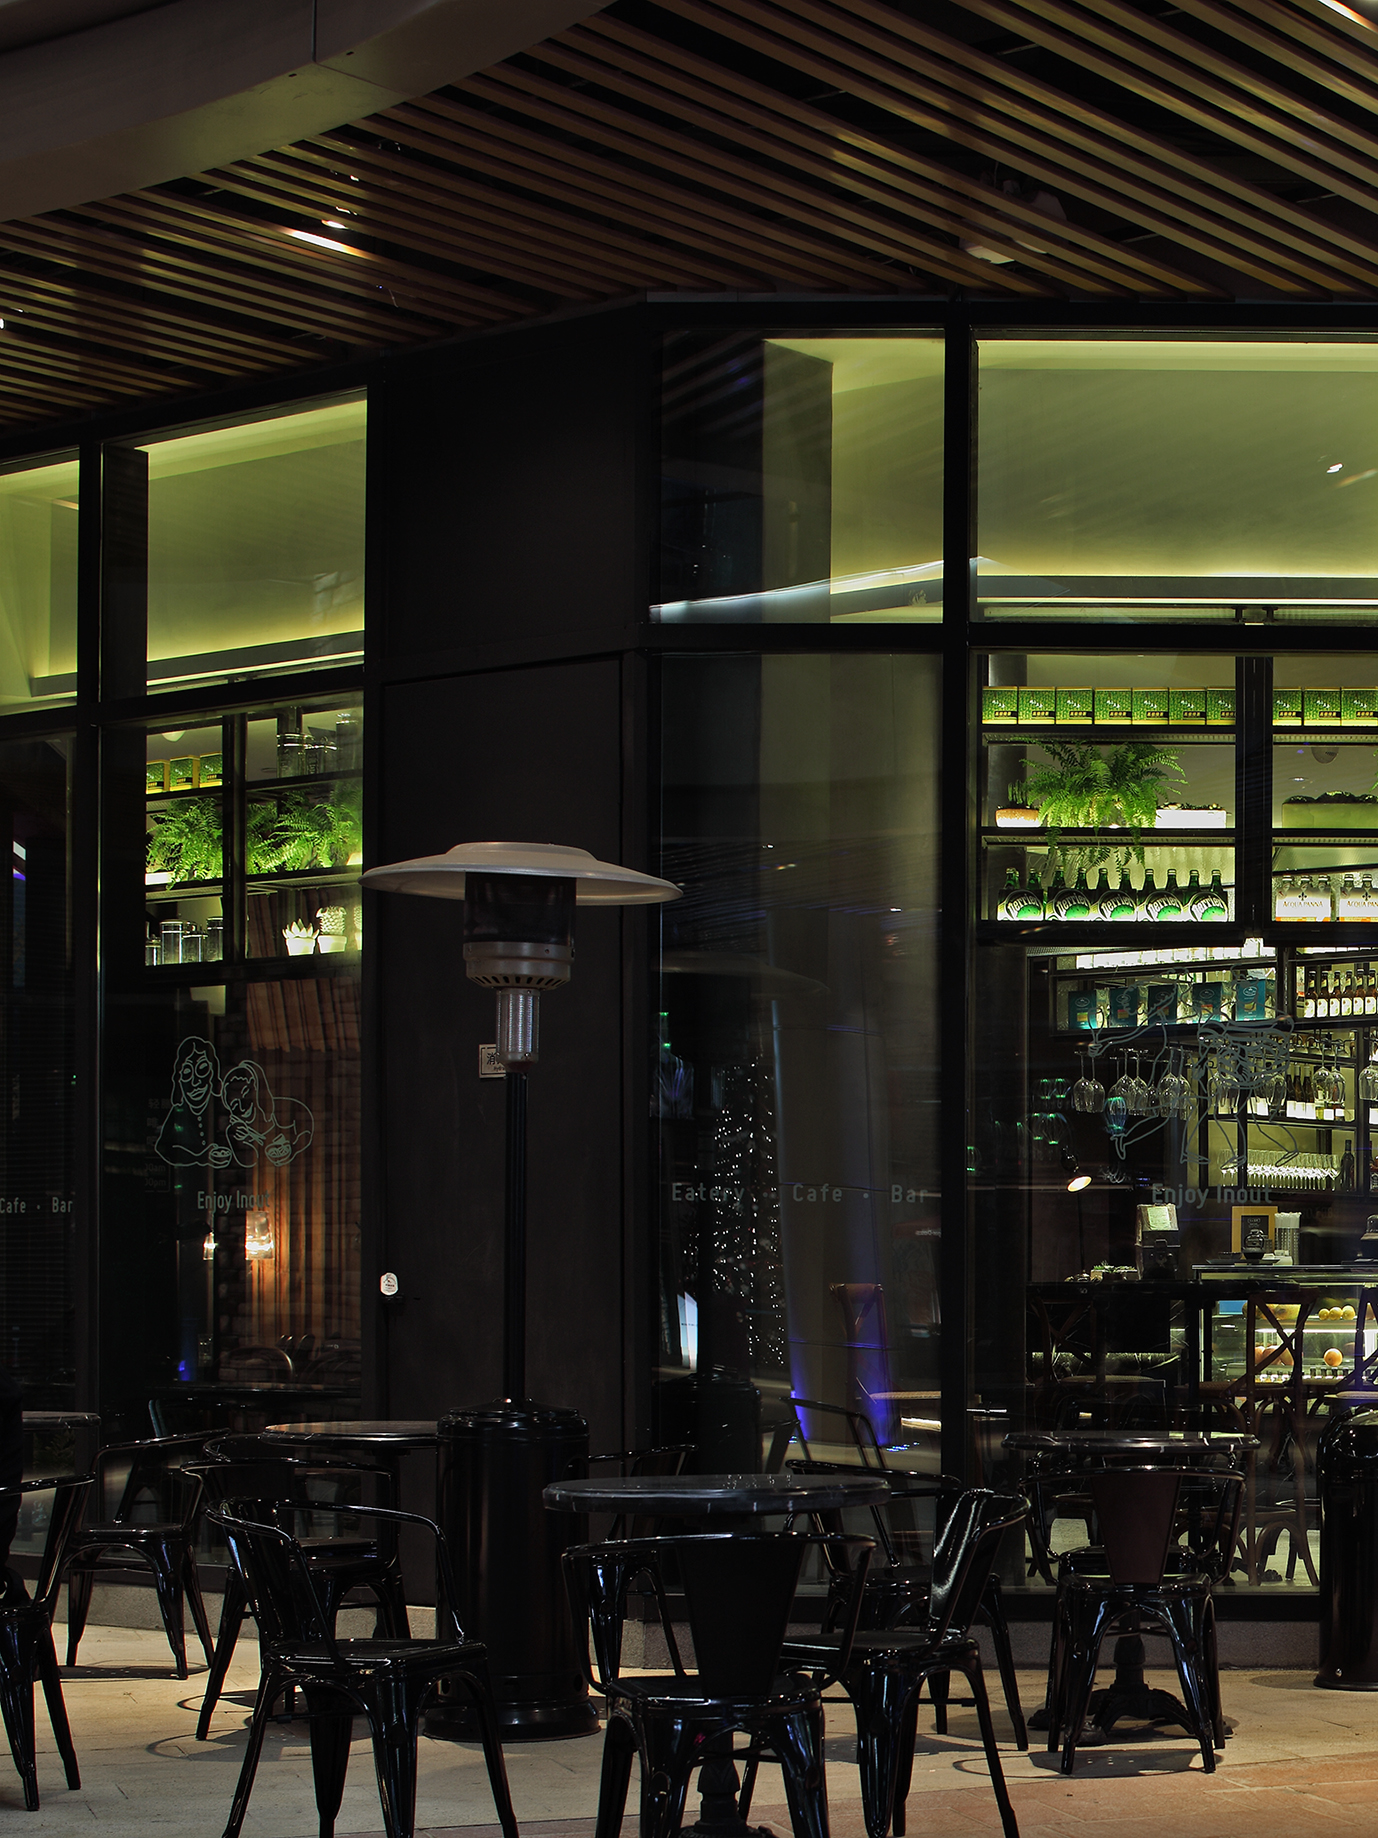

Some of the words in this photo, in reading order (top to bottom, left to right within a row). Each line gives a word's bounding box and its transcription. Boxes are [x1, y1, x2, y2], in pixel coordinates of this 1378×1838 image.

[197, 1190, 232, 1214] Enjoy
[236, 1189, 270, 1209] Inout
[792, 1183, 843, 1203] Cafe
[890, 1184, 928, 1203] Bar
[1152, 1183, 1210, 1209] Enjoy
[1216, 1183, 1273, 1204] Inout
[0, 1197, 27, 1214] Cafe
[52, 1197, 73, 1213] Bar
